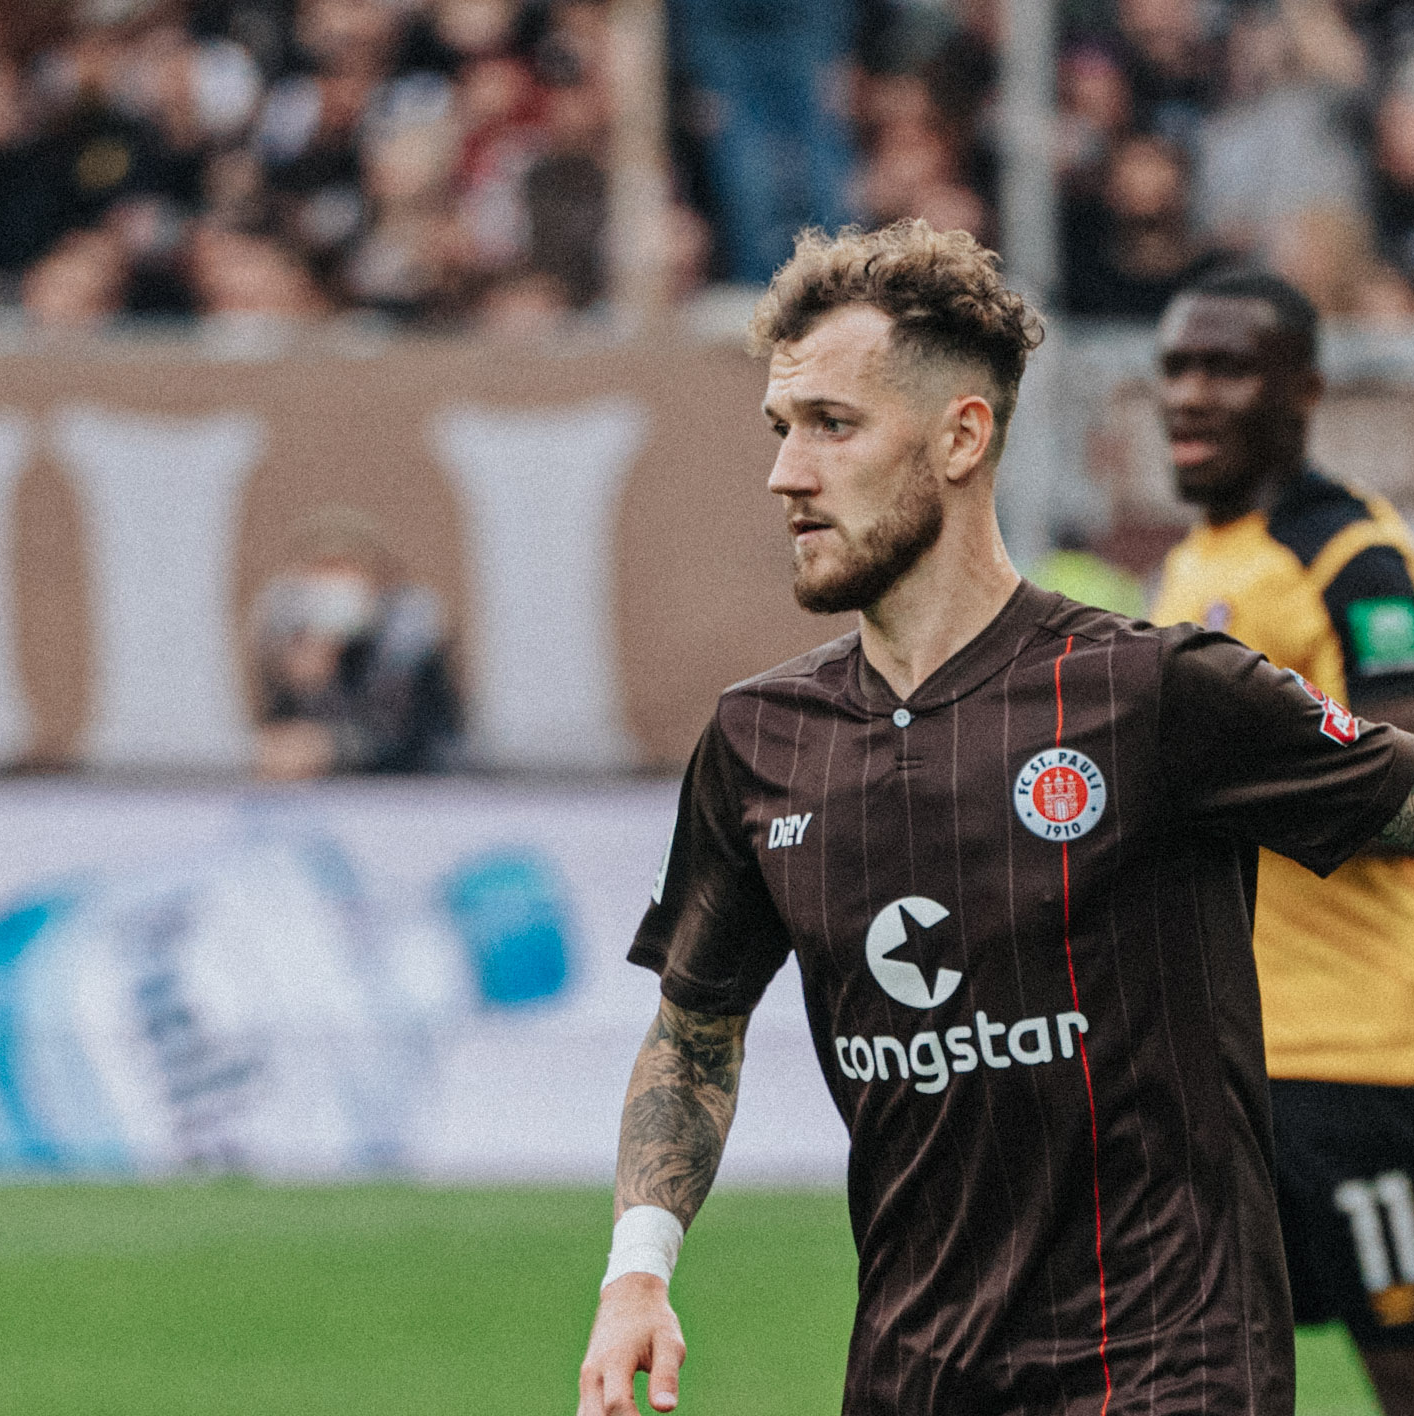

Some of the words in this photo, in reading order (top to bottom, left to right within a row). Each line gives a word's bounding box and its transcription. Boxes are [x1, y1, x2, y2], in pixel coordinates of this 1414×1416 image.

[1018, 777, 1033, 796] FC
[1030, 756, 1053, 775] ST.
[1058, 752, 1102, 790] PAULI
[1046, 822, 1082, 838] 1910
[835, 1010, 1089, 1095] congstar
